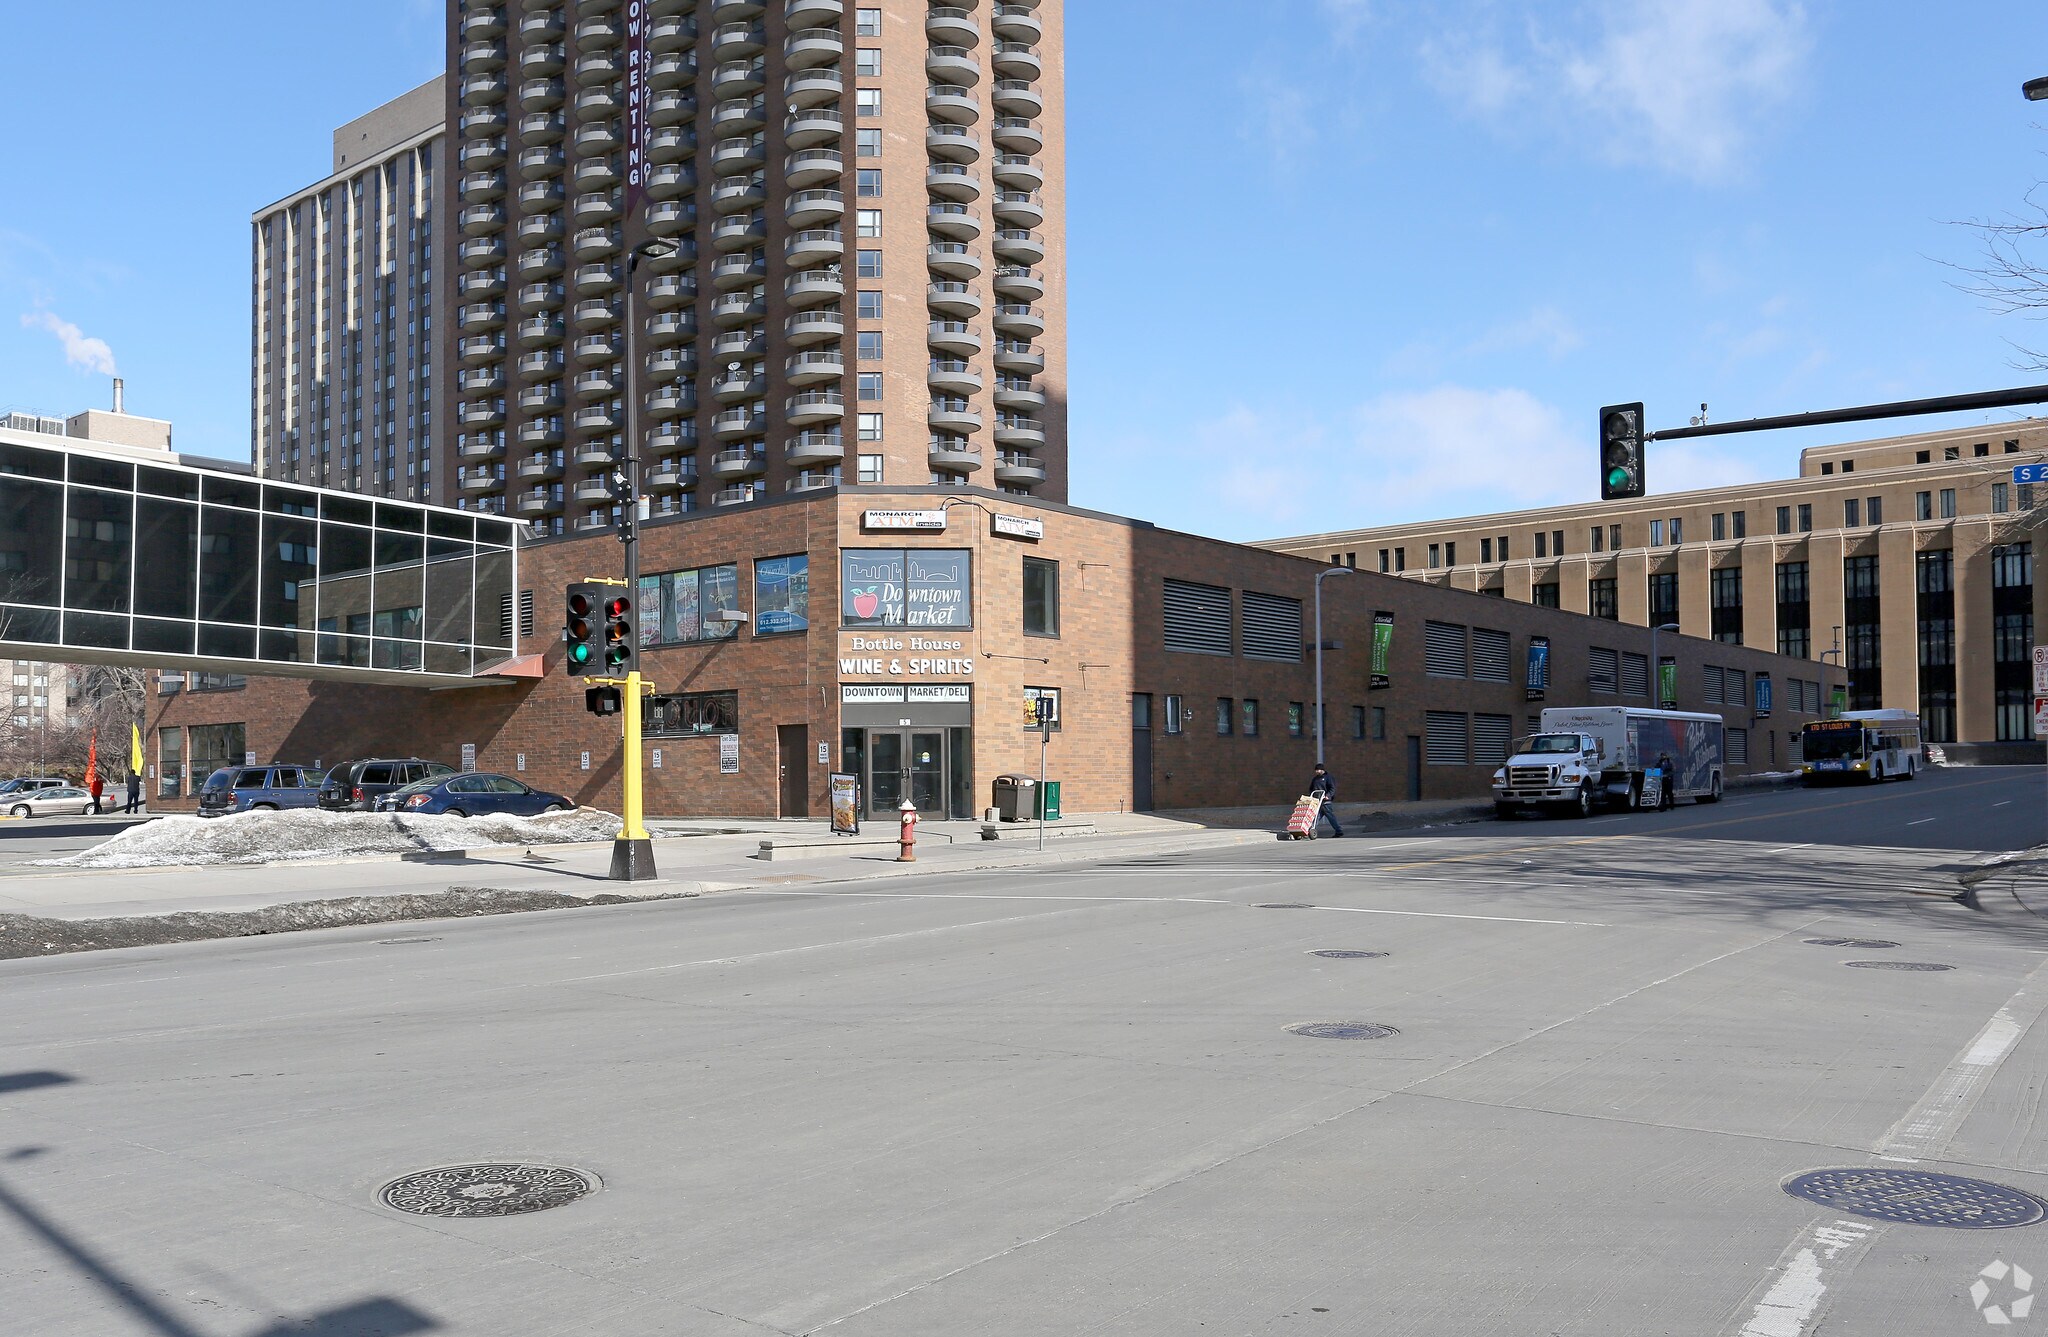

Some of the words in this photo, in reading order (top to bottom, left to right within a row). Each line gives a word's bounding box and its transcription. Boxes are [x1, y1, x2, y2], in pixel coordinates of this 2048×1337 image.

[629, 1, 640, 38] OW
[629, 49, 640, 186] RENTING
[2021, 468, 2031, 480] S
[871, 516, 914, 527] ATM
[997, 516, 1030, 525] MONARCH
[998, 523, 1025, 534] ATM
[881, 582, 962, 605] Downtown
[884, 604, 956, 625] Market
[851, 637, 904, 652] Bottle
[909, 637, 962, 652] House
[839, 658, 883, 675] WINE
[889, 658, 904, 675] &
[908, 658, 974, 676] SPIRITS
[845, 687, 903, 697] DOWNTOWN
[909, 687, 968, 698] MARKET/DELI
[518, 754, 524, 762] 15
